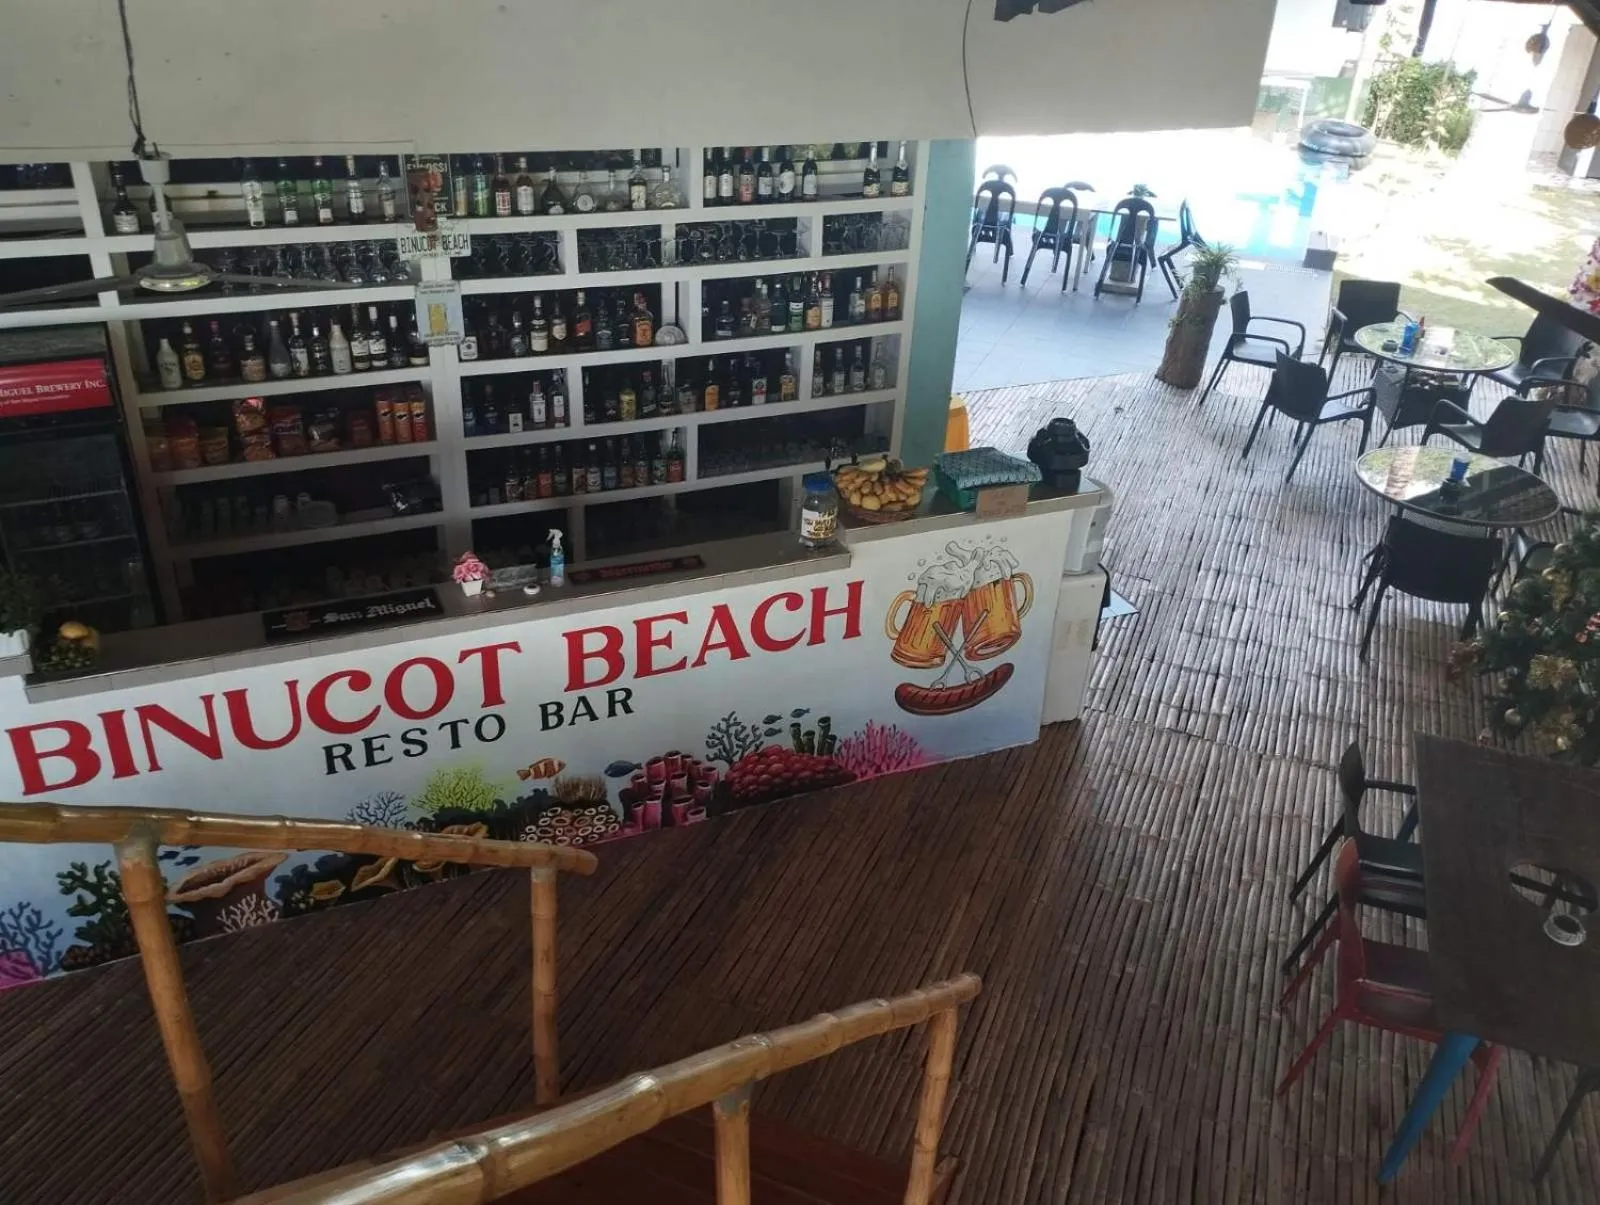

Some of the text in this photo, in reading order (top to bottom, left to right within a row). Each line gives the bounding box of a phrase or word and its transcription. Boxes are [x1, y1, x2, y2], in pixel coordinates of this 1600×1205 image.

[441, 233, 469, 251] BEACH
[35, 382, 82, 394] BREWERY
[323, 597, 436, 625] San Miguel
[5, 580, 865, 796] BINUCOT BEACH
[322, 687, 636, 776] RESTO BAR
